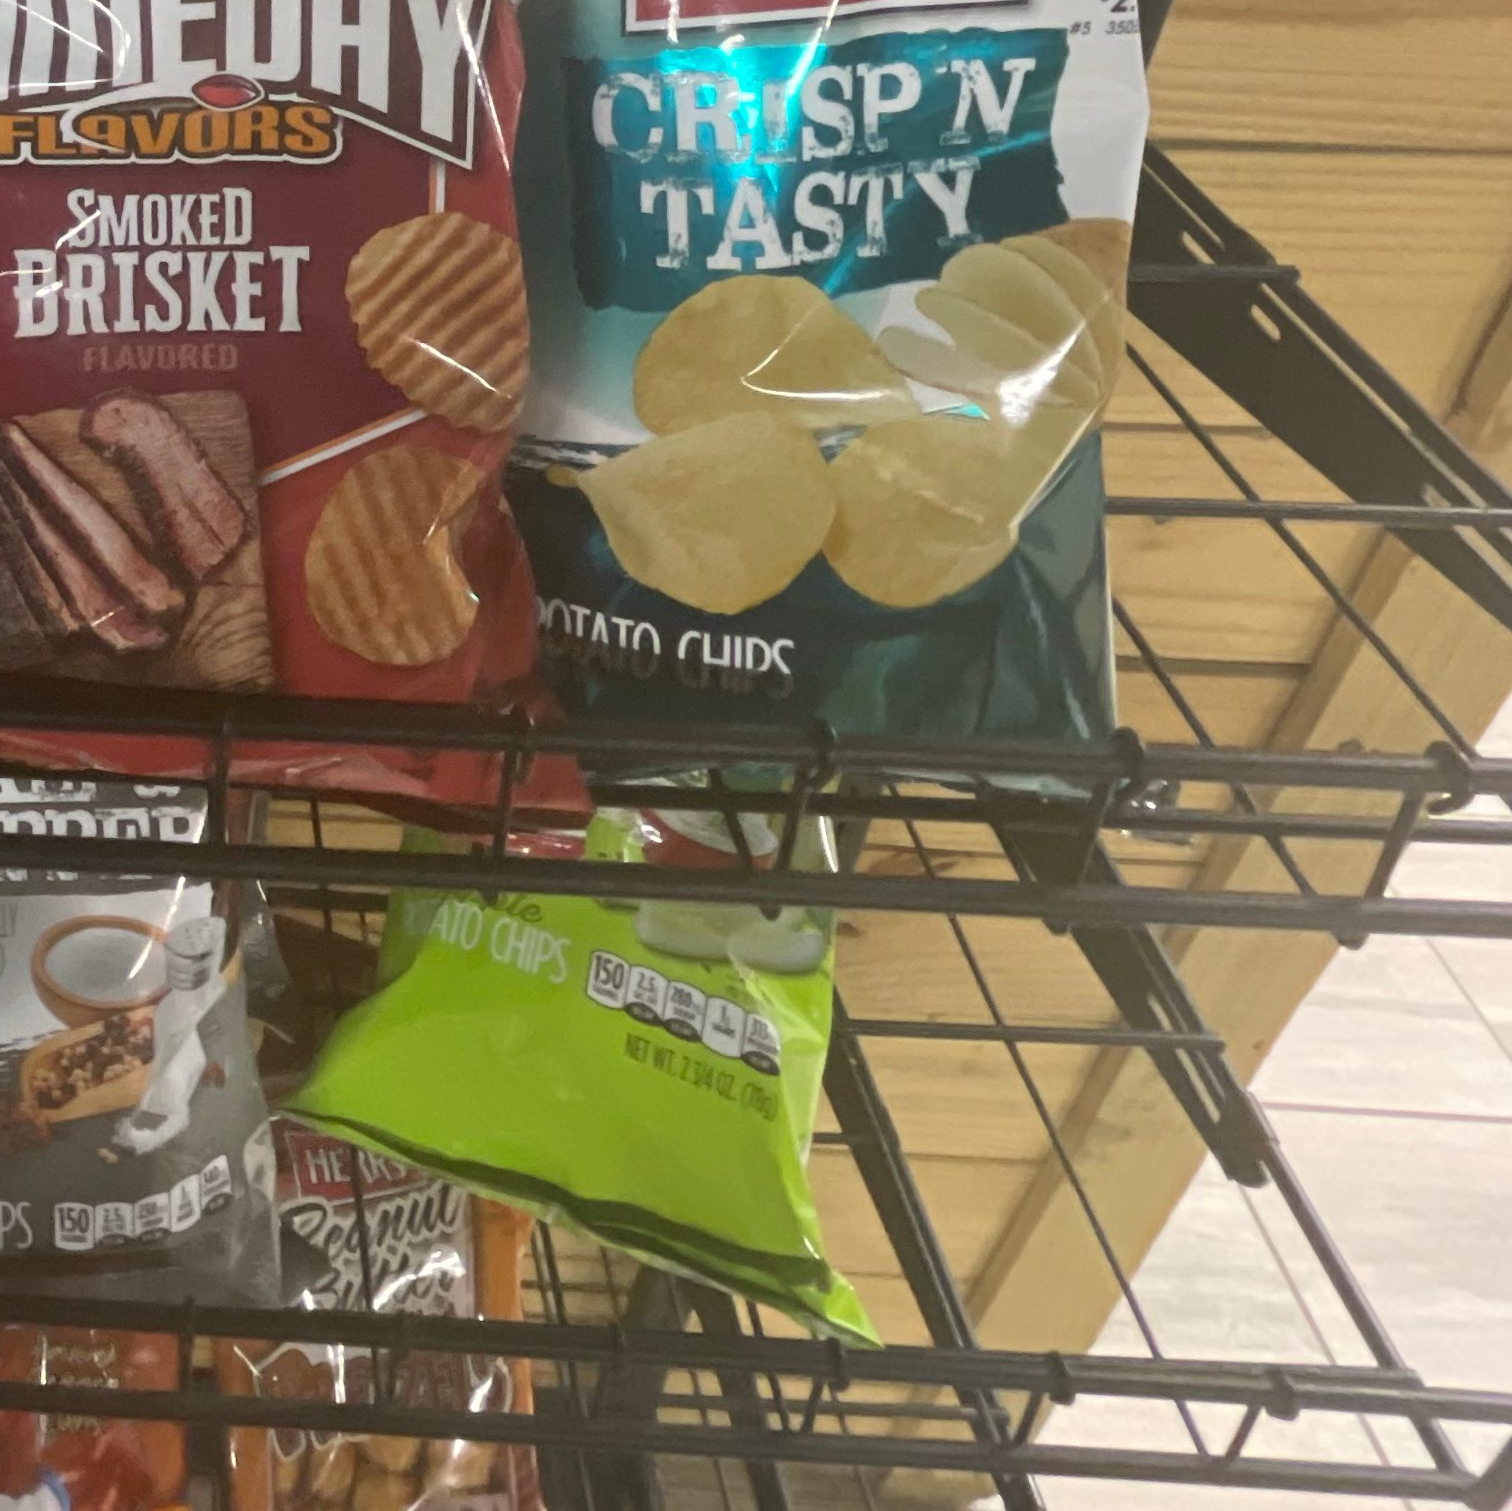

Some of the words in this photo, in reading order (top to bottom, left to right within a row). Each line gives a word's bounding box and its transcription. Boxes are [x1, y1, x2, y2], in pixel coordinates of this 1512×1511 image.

[67, 186, 254, 248] SMOKED
[639, 157, 985, 272] TASTY
[13, 245, 310, 339] BRISKET
[82, 342, 239, 373] FLAVORED
[678, 629, 795, 700] CHIPS
[405, 898, 483, 951] ATO
[491, 916, 571, 985] CHIPS
[593, 954, 625, 989] 150
[57, 1207, 90, 1234] 150
